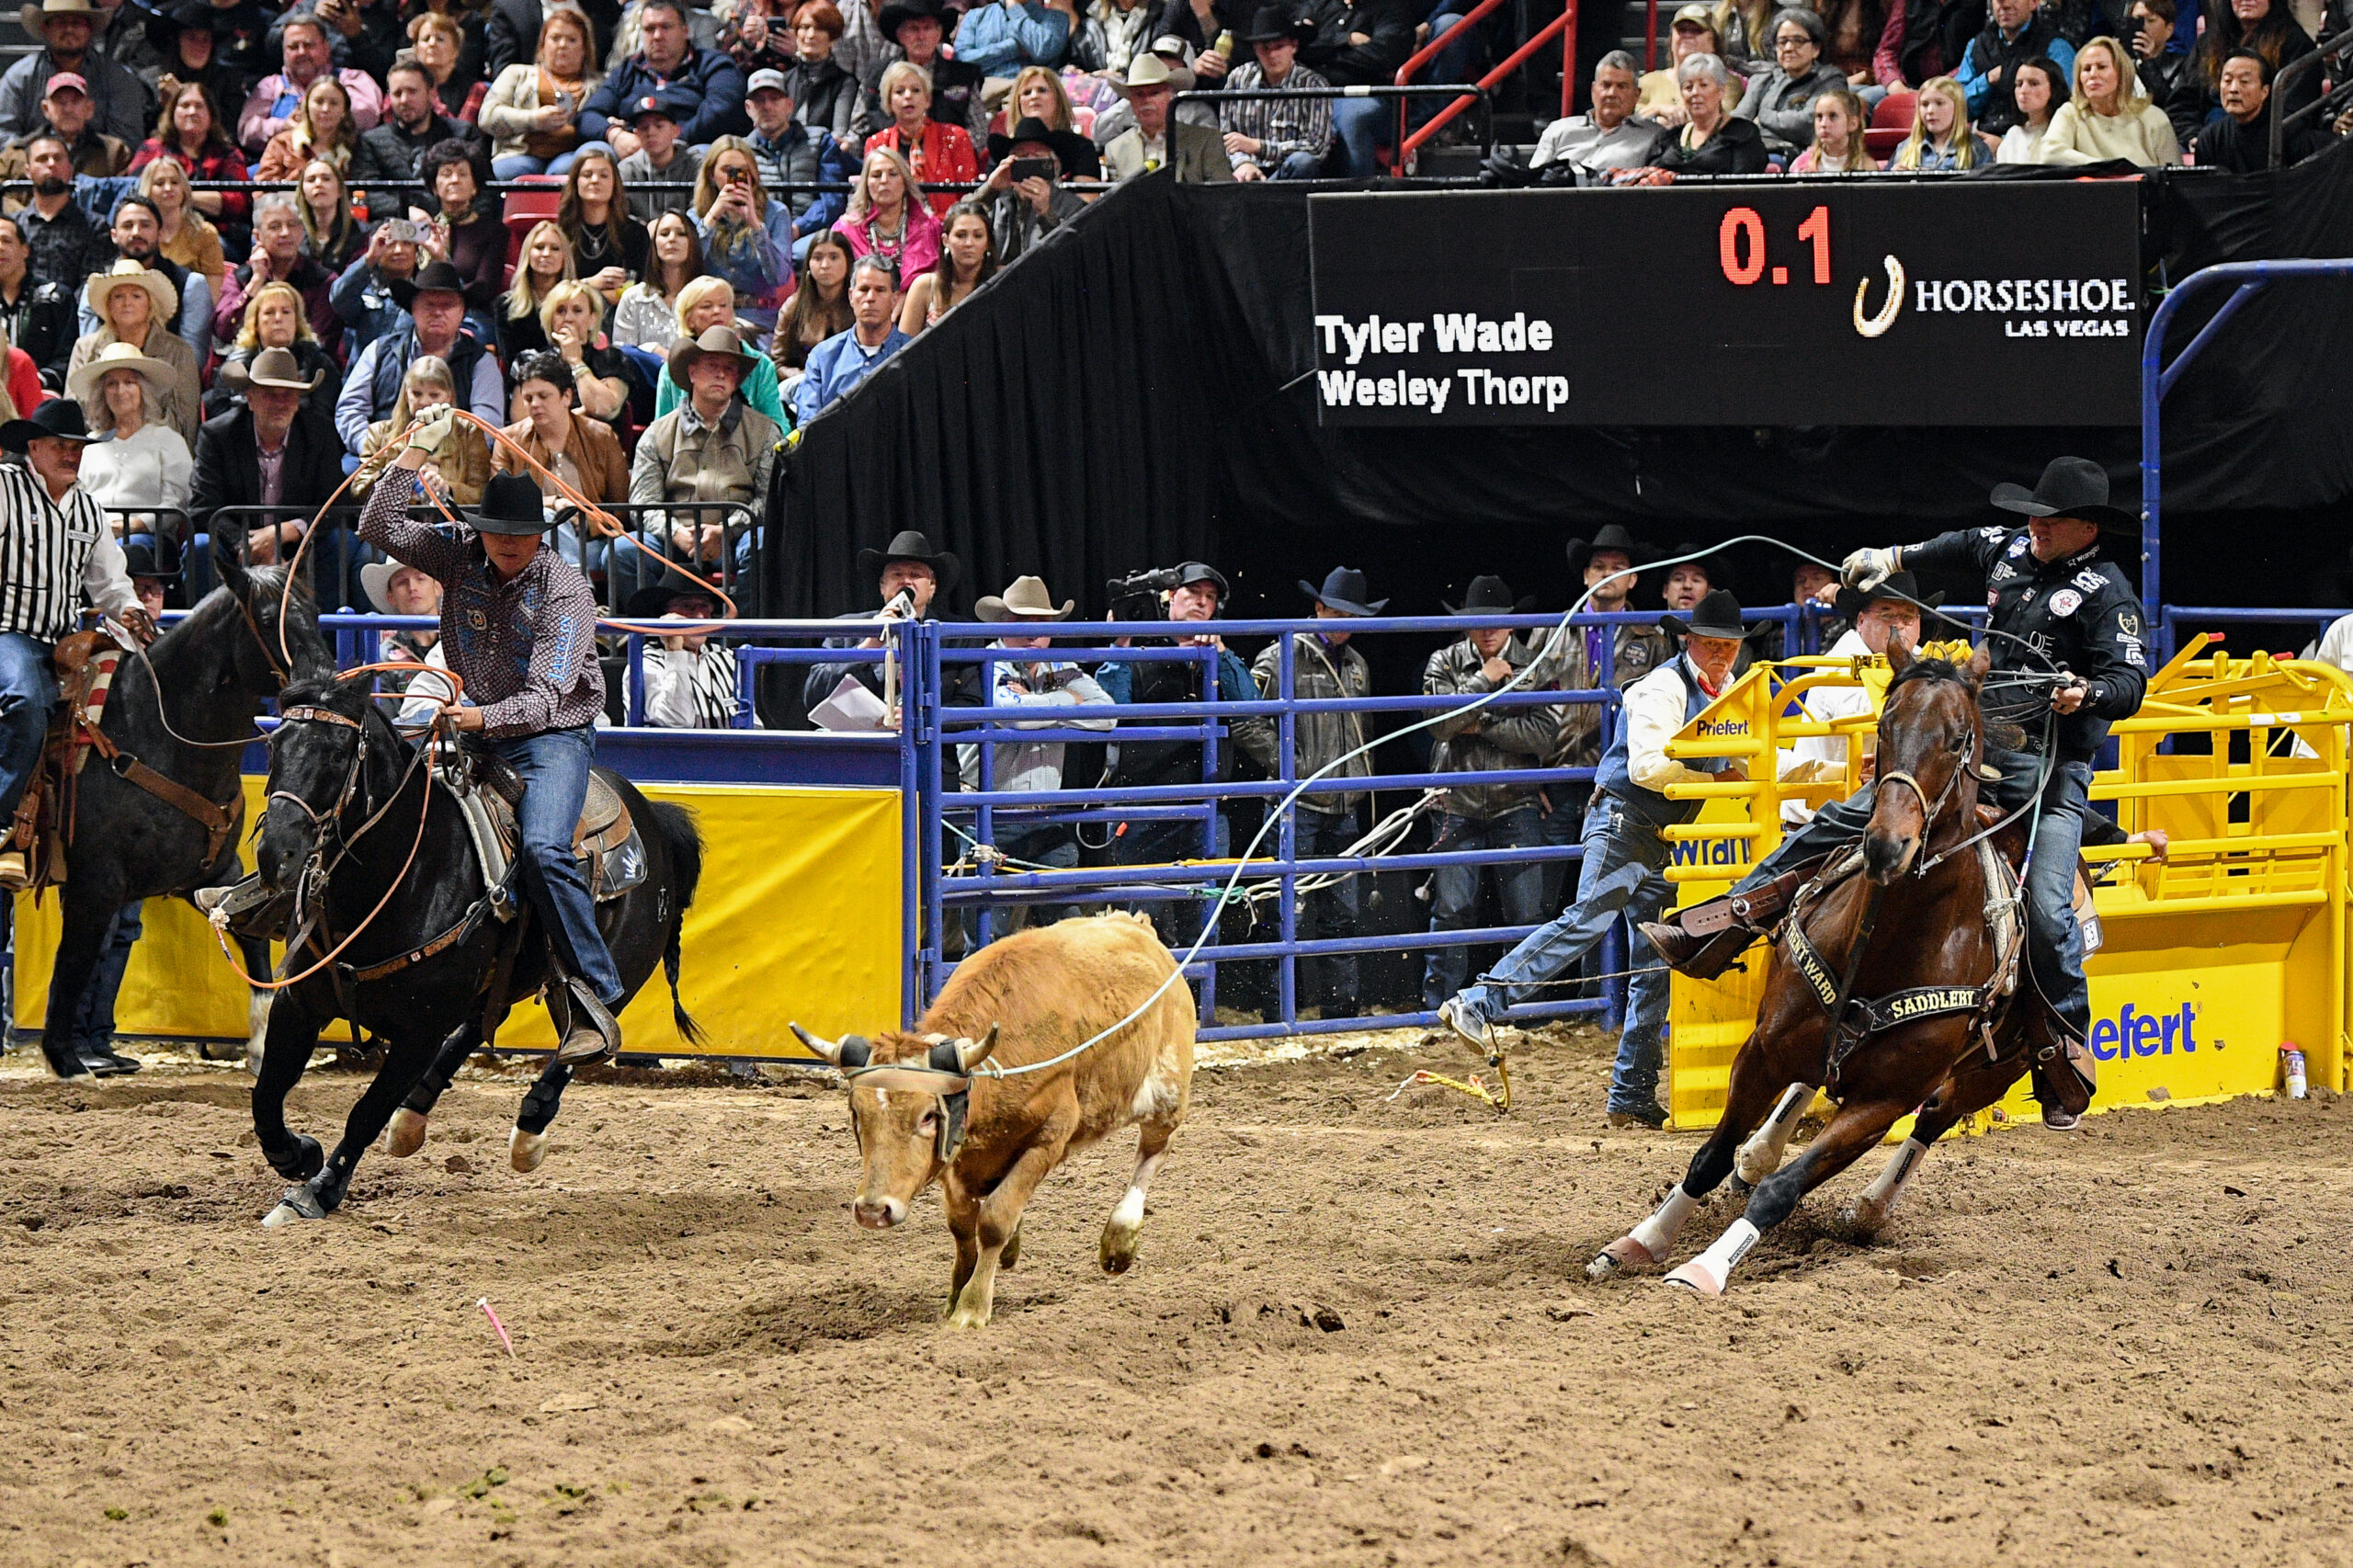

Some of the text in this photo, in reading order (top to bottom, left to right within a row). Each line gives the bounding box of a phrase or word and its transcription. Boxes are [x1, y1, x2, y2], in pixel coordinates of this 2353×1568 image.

[1719, 206, 1831, 285] 0.1
[1915, 278, 2136, 313] HORSESHOE
[1314, 312, 1553, 365] Tyler Wade
[2005, 320, 2130, 337] LAS VEGAS
[1317, 369, 1569, 414] Wesley Thorp
[1696, 716, 1749, 736] Priefert
[1785, 921, 1837, 1006] TRENT WARD
[1891, 989, 1976, 1019] SADDLERY
[2085, 1001, 2196, 1061] efert
